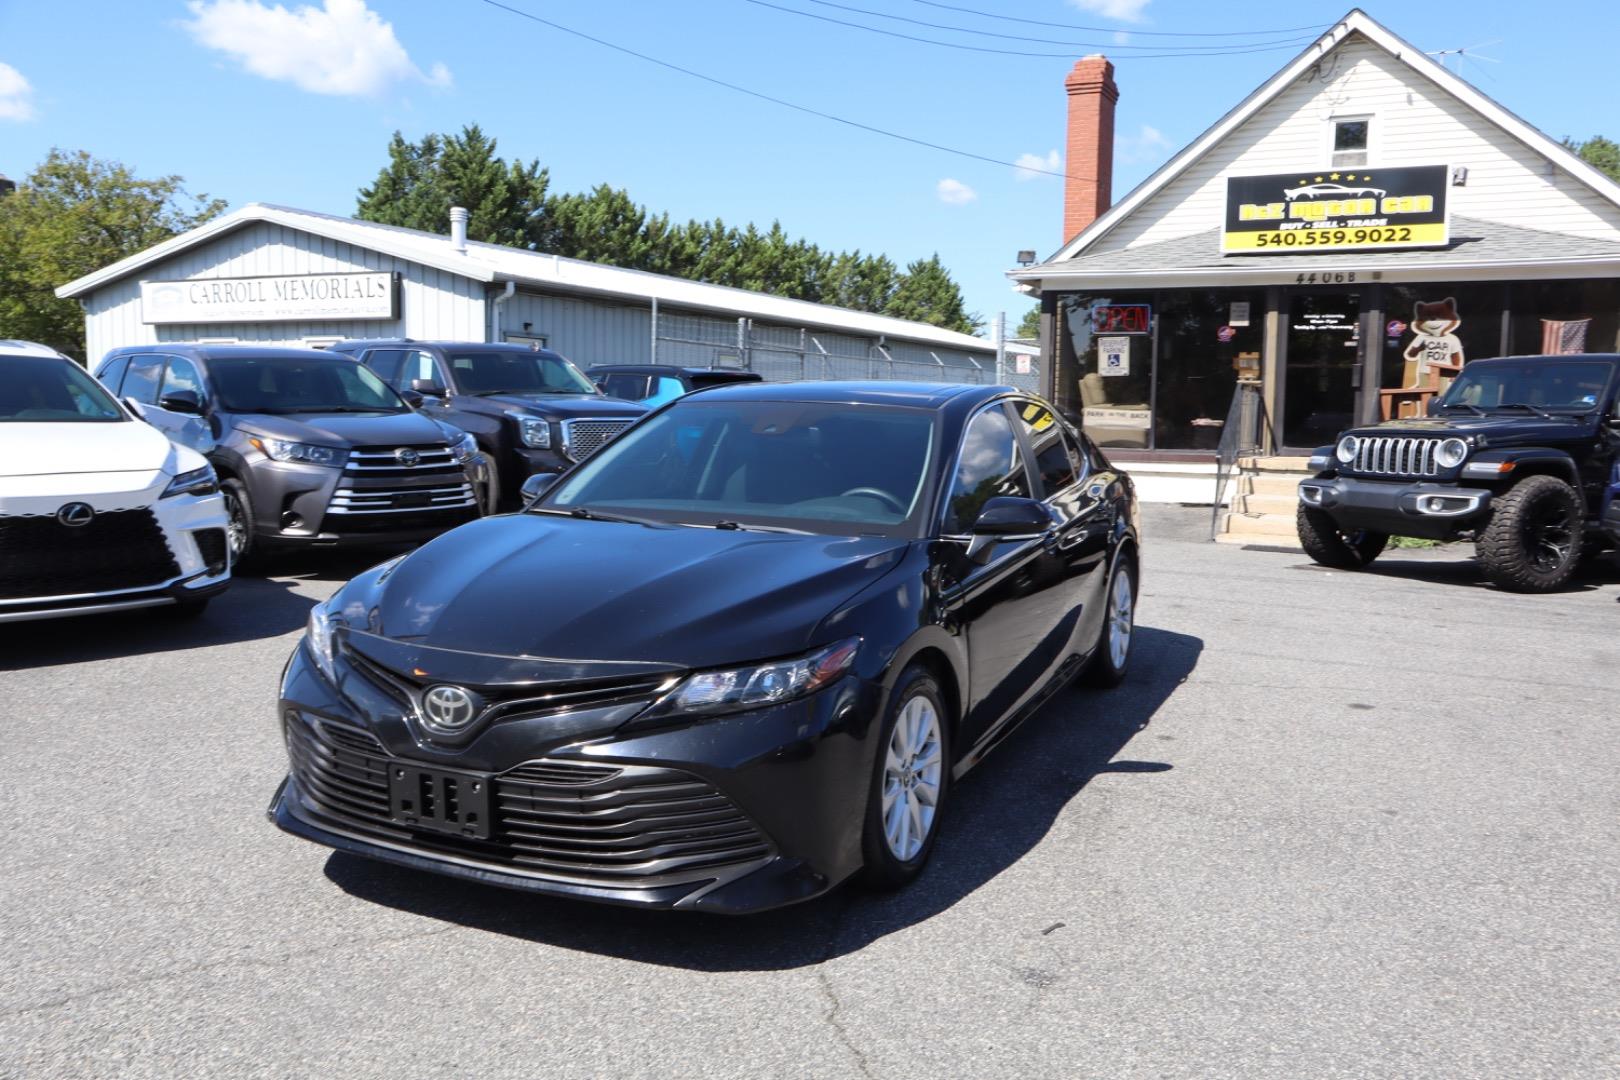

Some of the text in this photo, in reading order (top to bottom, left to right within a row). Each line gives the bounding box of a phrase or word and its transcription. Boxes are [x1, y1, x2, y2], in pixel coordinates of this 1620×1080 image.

[1279, 222, 1305, 230] BUY
[1312, 220, 1339, 229] SELL
[1347, 218, 1388, 227] TRADE
[1256, 228, 1411, 247] 540.559.9022
[189, 277, 386, 304] CARROLL MEMORIALS
[1095, 307, 1147, 331] OPEN
[1427, 351, 1447, 361] FOX
